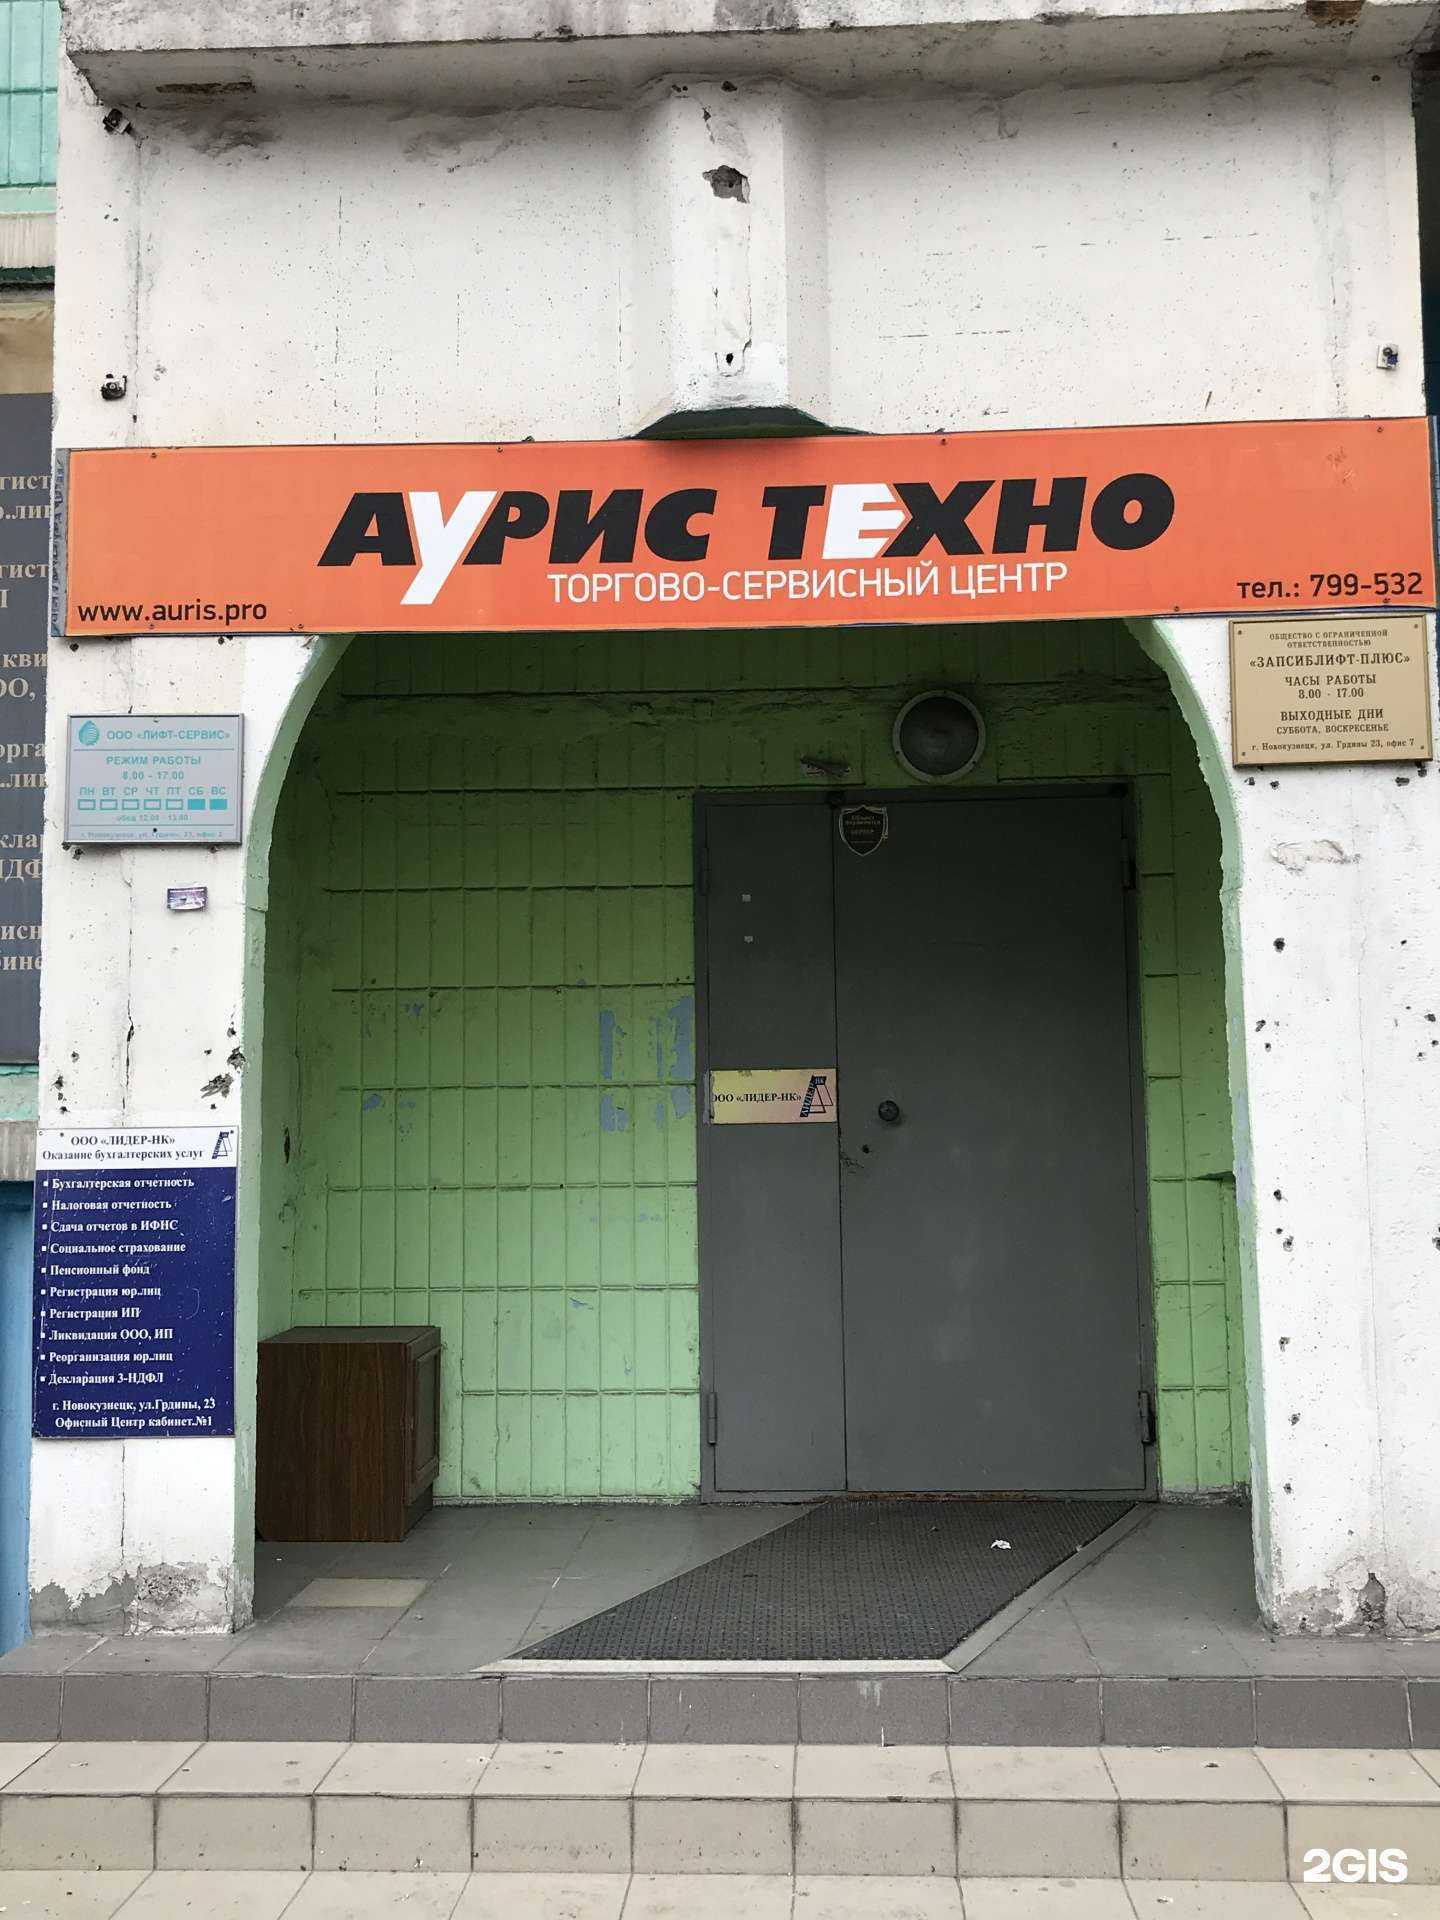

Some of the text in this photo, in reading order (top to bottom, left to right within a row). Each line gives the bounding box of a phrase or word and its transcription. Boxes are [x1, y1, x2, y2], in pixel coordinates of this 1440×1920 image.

[762, 473, 1175, 560] ТЕХНО
[547, 560, 1068, 602] ТОРГОВО-СЕРВИСНЫЙ ЦЕНТР
[1237, 572, 1423, 598] тел.: 799-532
[77, 599, 267, 625] www.auris.pro
[1270, 632, 1313, 640] ОБЩЕСТВО
[1323, 629, 1388, 639] ОГРАНИЧЕННОЙ
[1287, 639, 1371, 648] ОТВЕТСТВЕННОСТЬЮ
[1249, 652, 1410, 668] «ЗАПСИБЛИФТ-ПЛЮС»
[1285, 674, 1376, 686] ЧАСЫ РАБОТЫ
[1298, 688, 1321, 699] 8.00
[1337, 688, 1364, 698] 17.00
[1280, 708, 1383, 722] ВЫХОДНЫЕ ДНИ
[1325, 723, 1389, 733] ВОСКРЕСЕНЬЕ
[106, 730, 231, 740] ООО «ЛИФТ-СЕРВИС»
[1409, 738, 1415, 746] 7
[106, 755, 201, 765] РЕЖИМ РАБОТЫ
[79, 786, 226, 795] ПН ВТ СР ЧТ ПТ СБ ВС
[736, 1093, 801, 1103] «ЛИДЕР-НК»
[71, 1135, 176, 1146] ООО «ЛИДЕР-НК»
[43, 1149, 203, 1162] Оказание бухгалтерских услуг
[52, 1178, 194, 1191] Бухгалтерская отчетность
[52, 1200, 172, 1210] Налоговая отчетность
[50, 1221, 84, 1233] Сдача
[86, 1223, 128, 1232] отчетов
[141, 1220, 178, 1231] ИФНС
[50, 1243, 186, 1254] Социальное страхование
[50, 1264, 150, 1277] Пенсионный фонд
[50, 1286, 161, 1297] Регистрация юр.лиц
[49, 1308, 140, 1320] Регистрация ИП
[49, 1328, 173, 1340] Ликвидация ООО, ИП
[49, 1352, 173, 1364] Реорганизация юр.лиц
[49, 1372, 164, 1385] Декларация 3-НДФЛ
[52, 1398, 215, 1412] г. Новокузнецк, ул.Грдины, 23
[55, 1416, 212, 1429] Офисный Центр кабинет.№1
